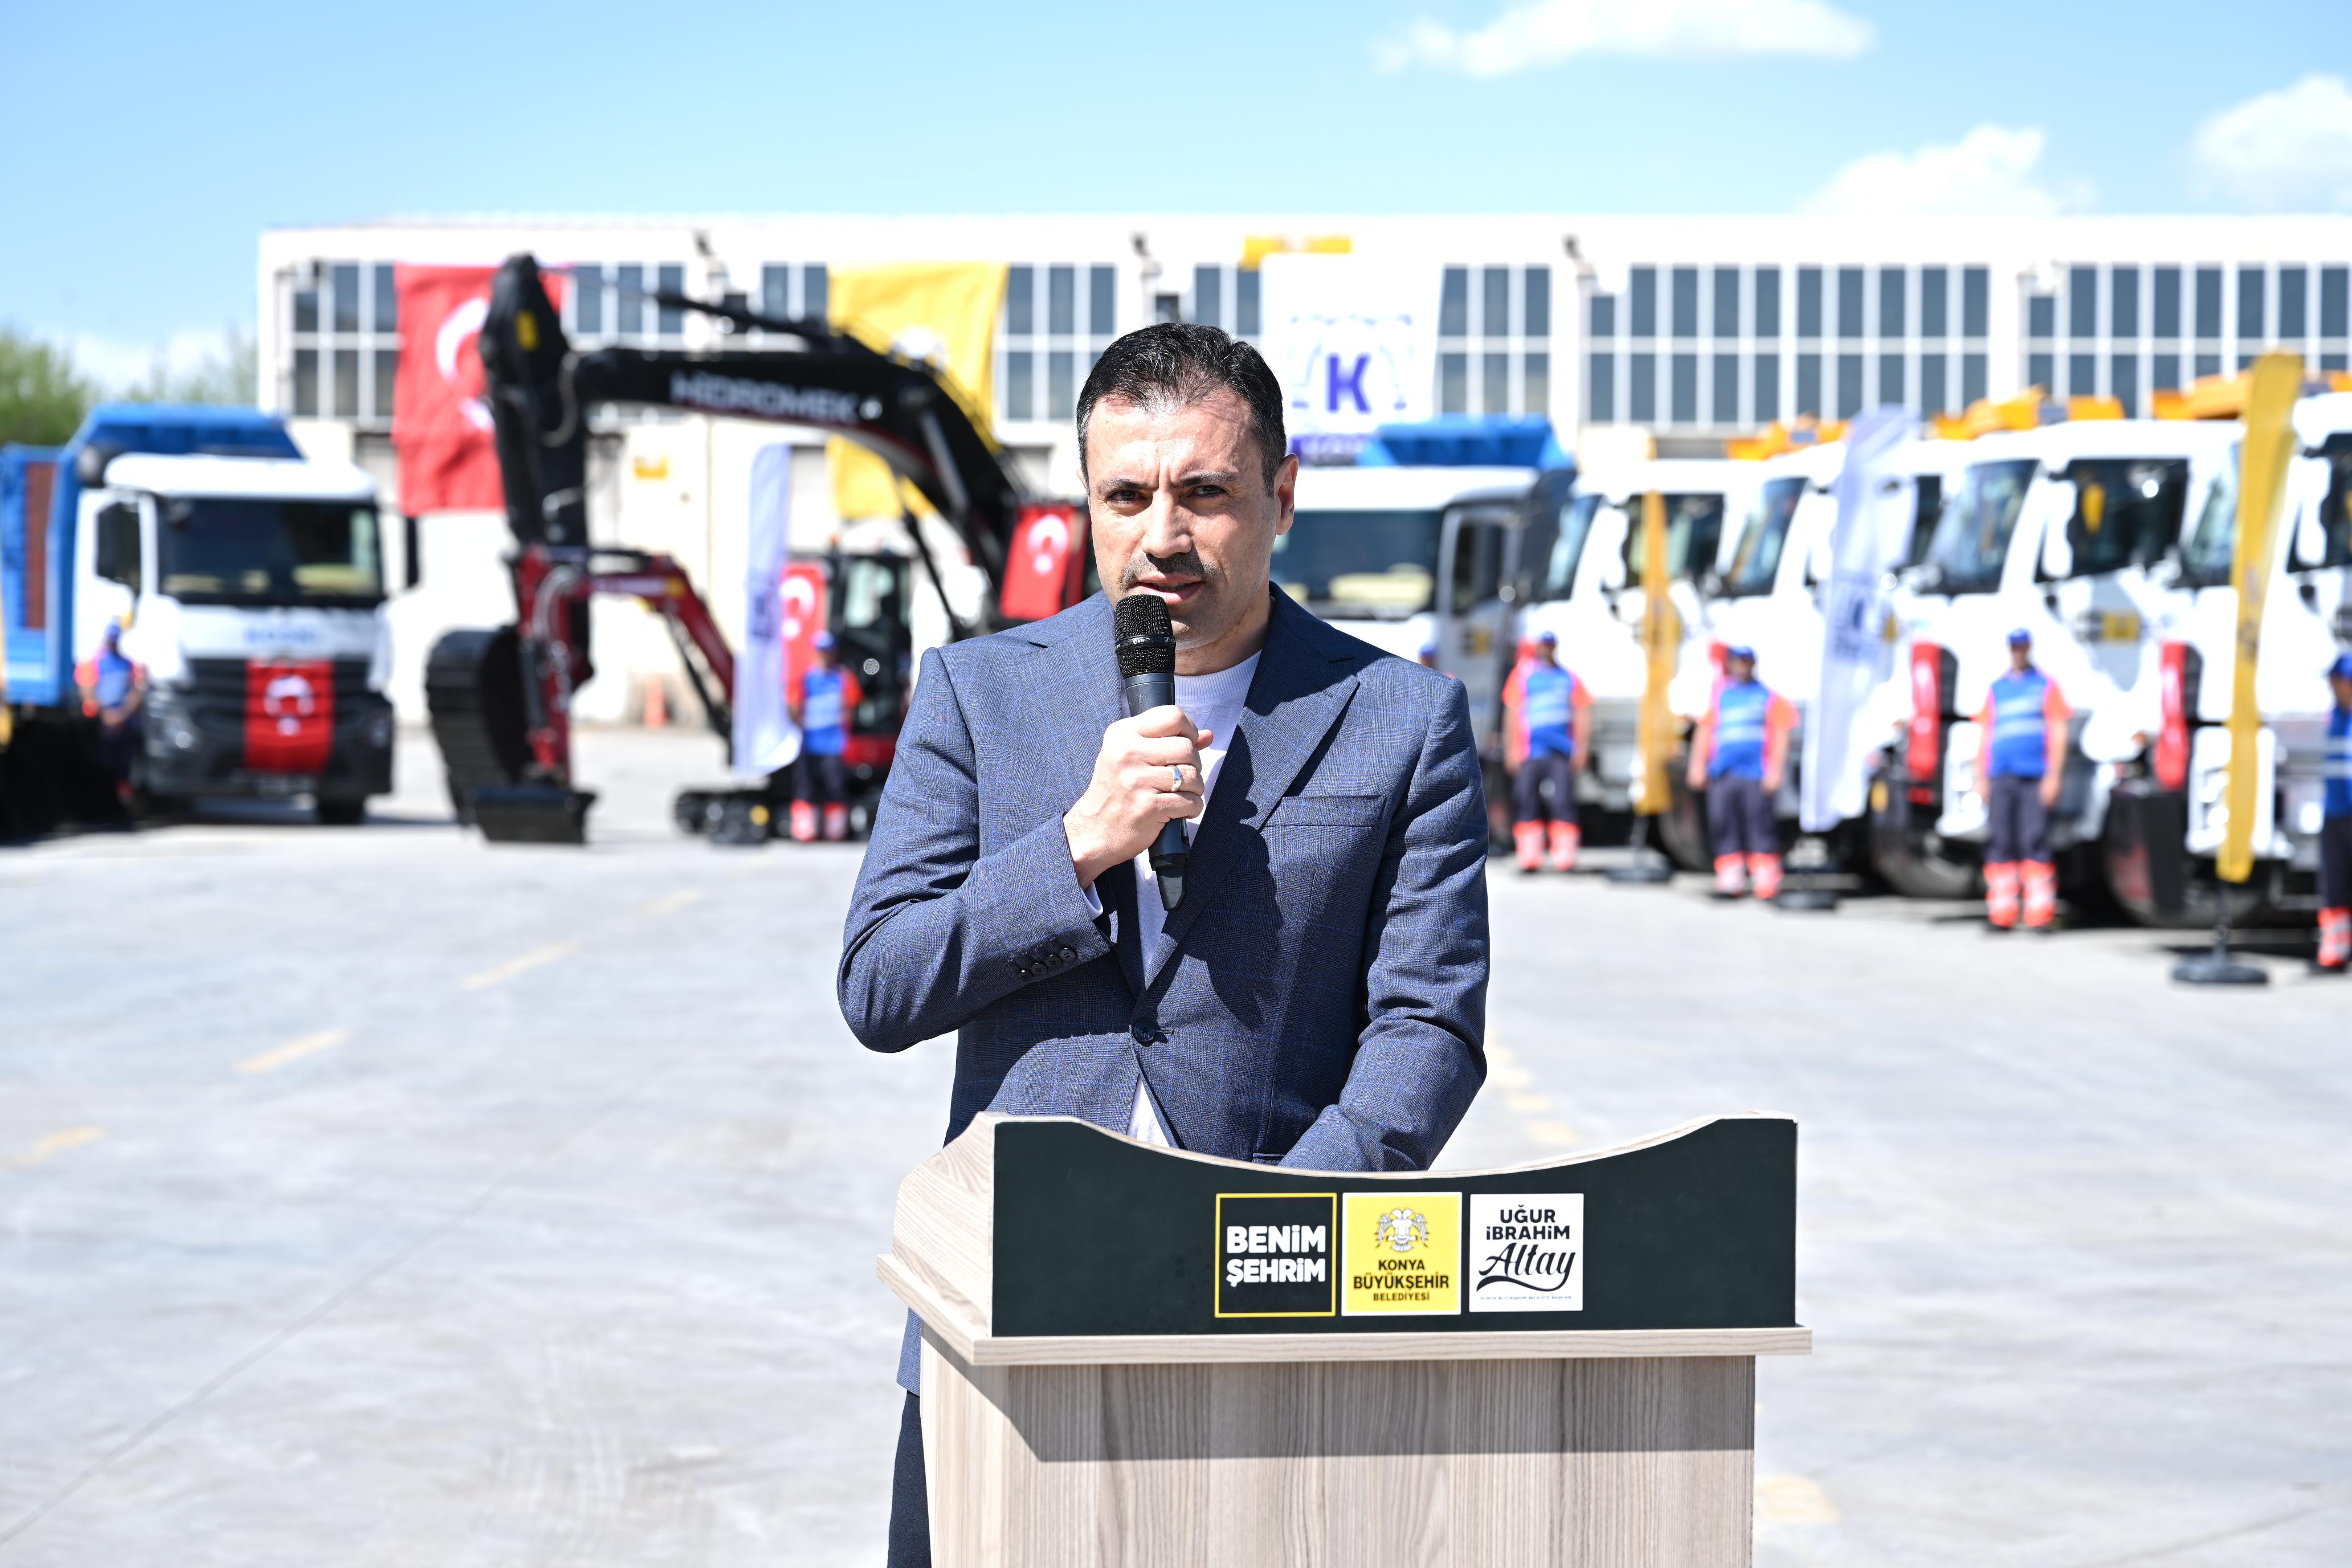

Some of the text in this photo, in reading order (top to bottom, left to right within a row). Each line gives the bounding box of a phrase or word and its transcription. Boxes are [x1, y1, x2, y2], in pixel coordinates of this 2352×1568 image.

[1326, 352, 1371, 414] K
[1500, 1204, 1556, 1223] UĞUR
[1227, 1225, 1326, 1253] BENİM
[1486, 1226, 1570, 1240] İBRAHİM
[1226, 1258, 1326, 1288] ŞEHRİM
[1378, 1259, 1425, 1271] KONYA
[1476, 1242, 1576, 1292] Altay
[1353, 1271, 1449, 1290] BÜYÜKŞEHİR
[1373, 1290, 1430, 1301] BELEDİYESİ
